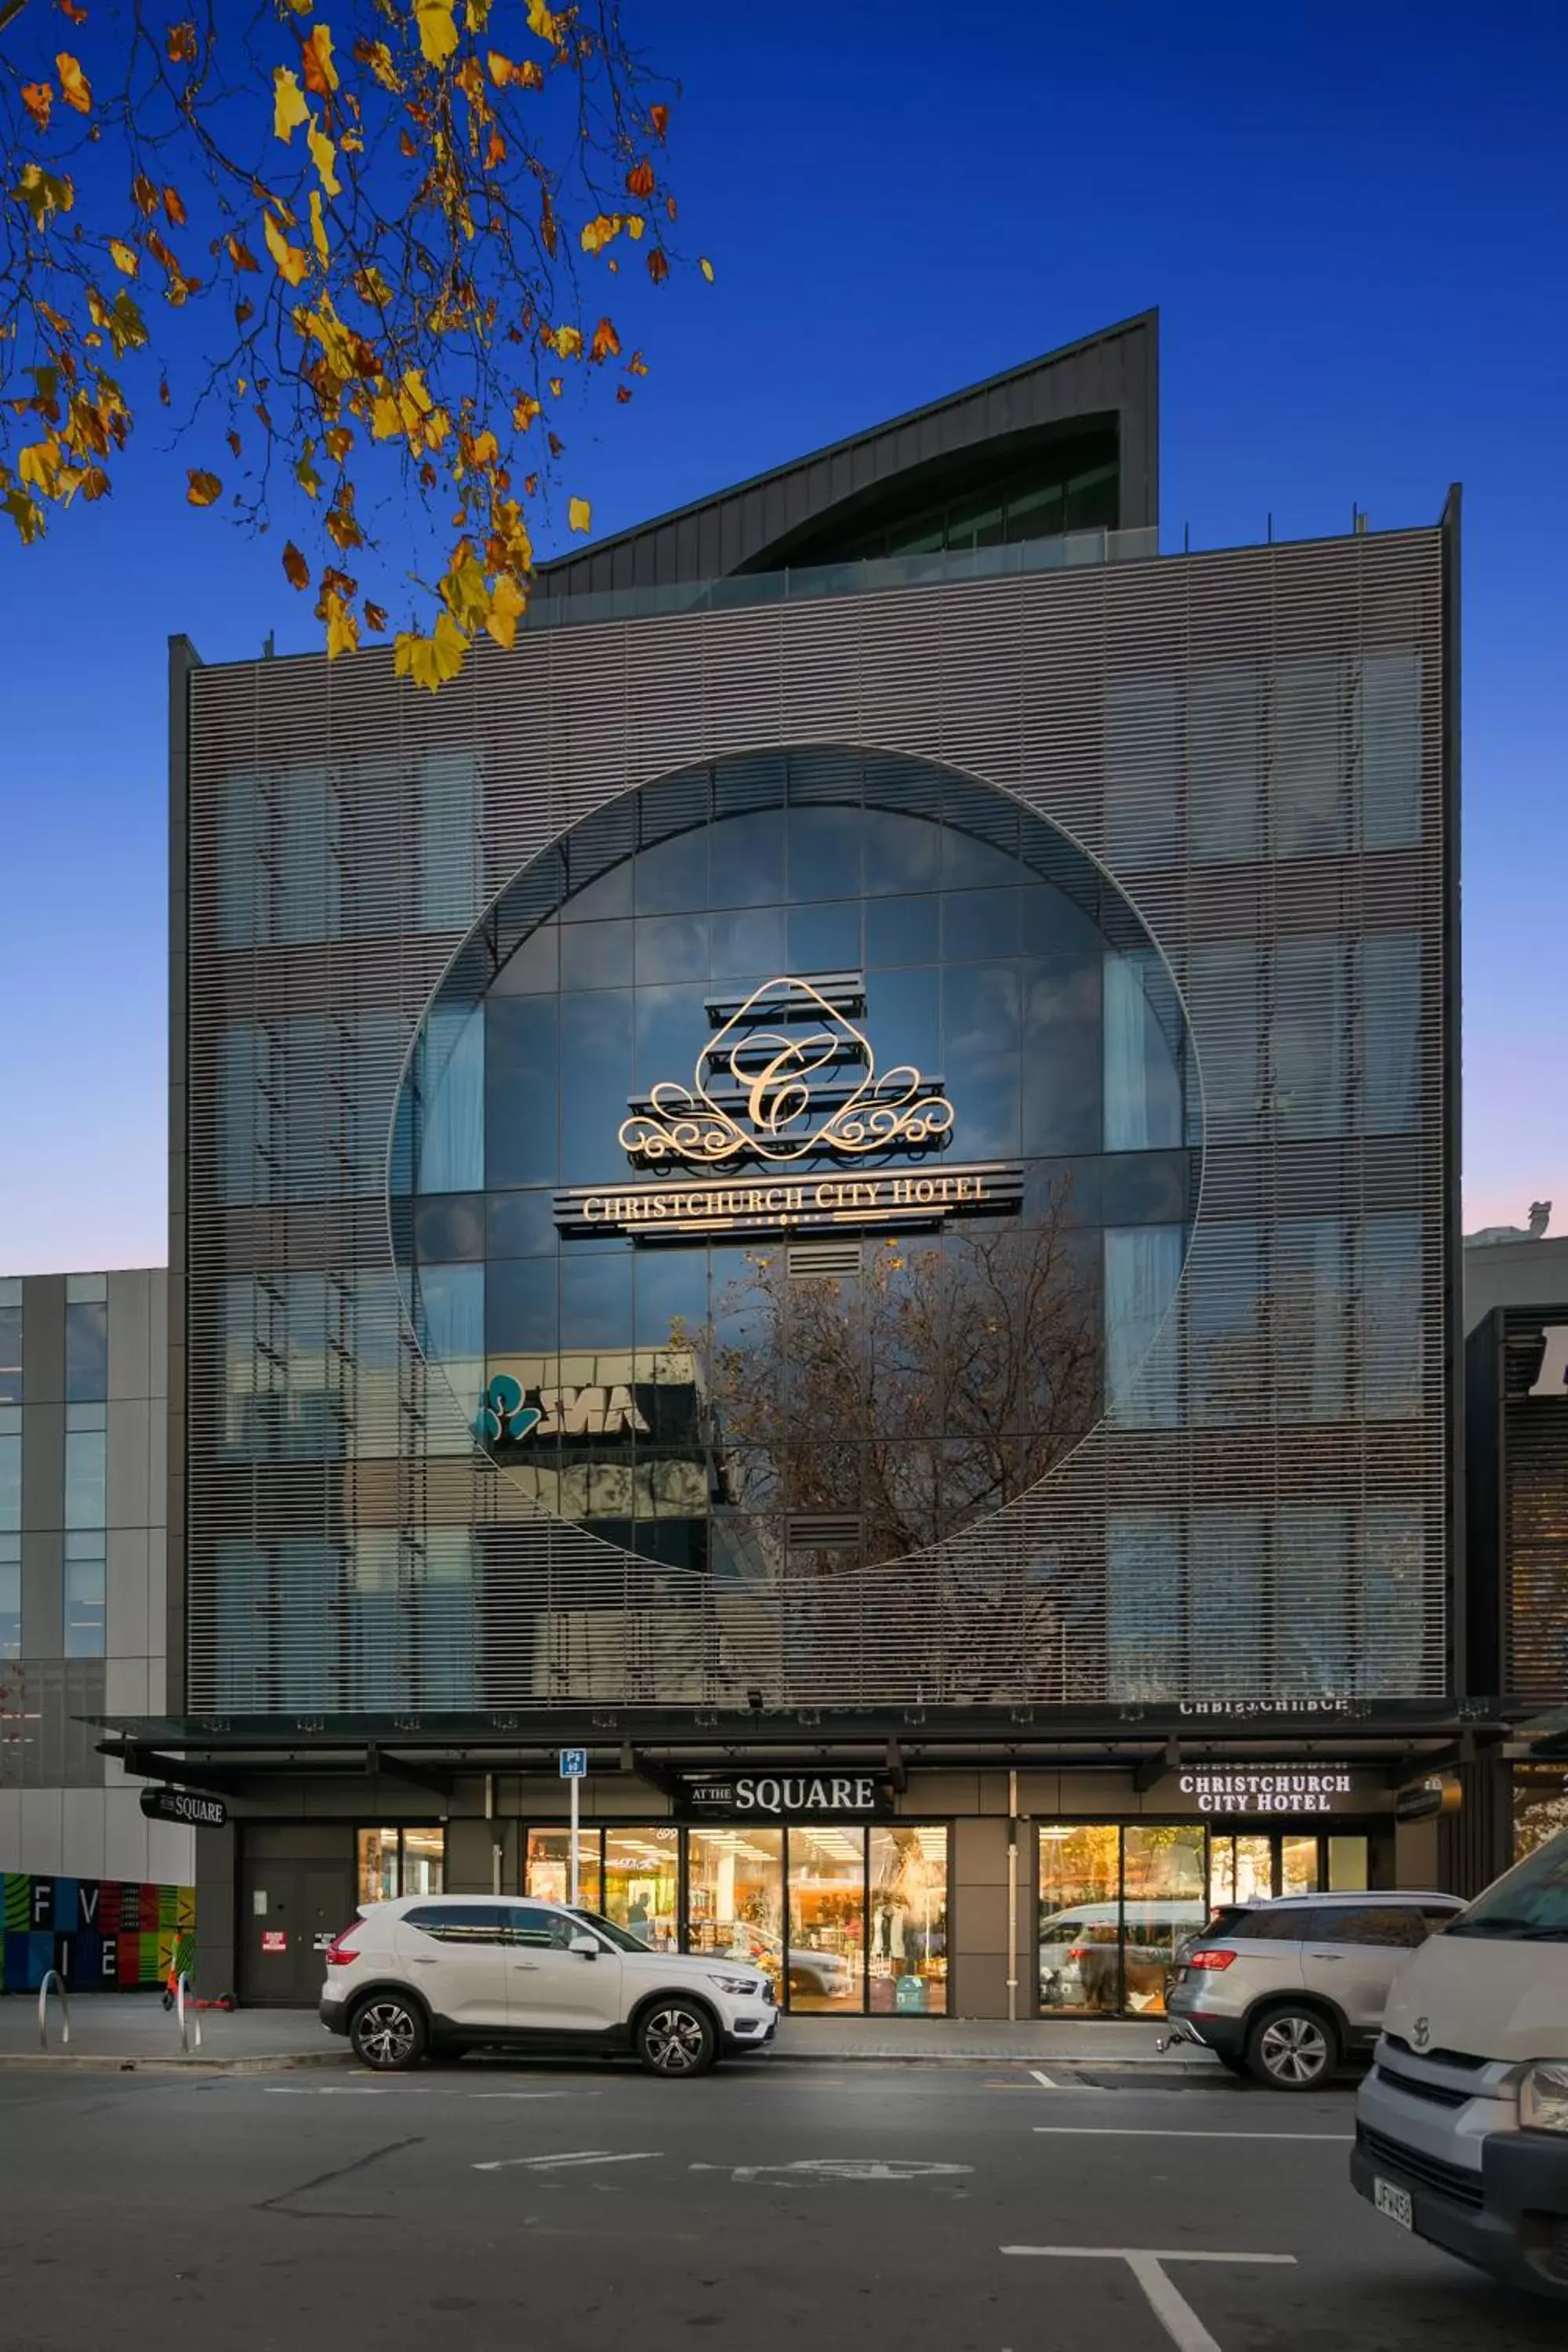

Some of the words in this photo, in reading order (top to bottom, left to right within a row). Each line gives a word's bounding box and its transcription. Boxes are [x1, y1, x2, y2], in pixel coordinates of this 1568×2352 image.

[583, 1187, 804, 1221] CHRISTCHURCH
[815, 1181, 880, 1208] CITY
[892, 1177, 990, 1204] HOTEL
[692, 1788, 706, 1799] AT
[707, 1788, 731, 1799] THE
[736, 1779, 874, 1813] SQUARE
[1179, 1776, 1350, 1793] CHRISTCHURCH
[175, 1795, 223, 1823] SQUARE
[1198, 1794, 1249, 1812] CITY
[1257, 1793, 1330, 1811] HOTEL
